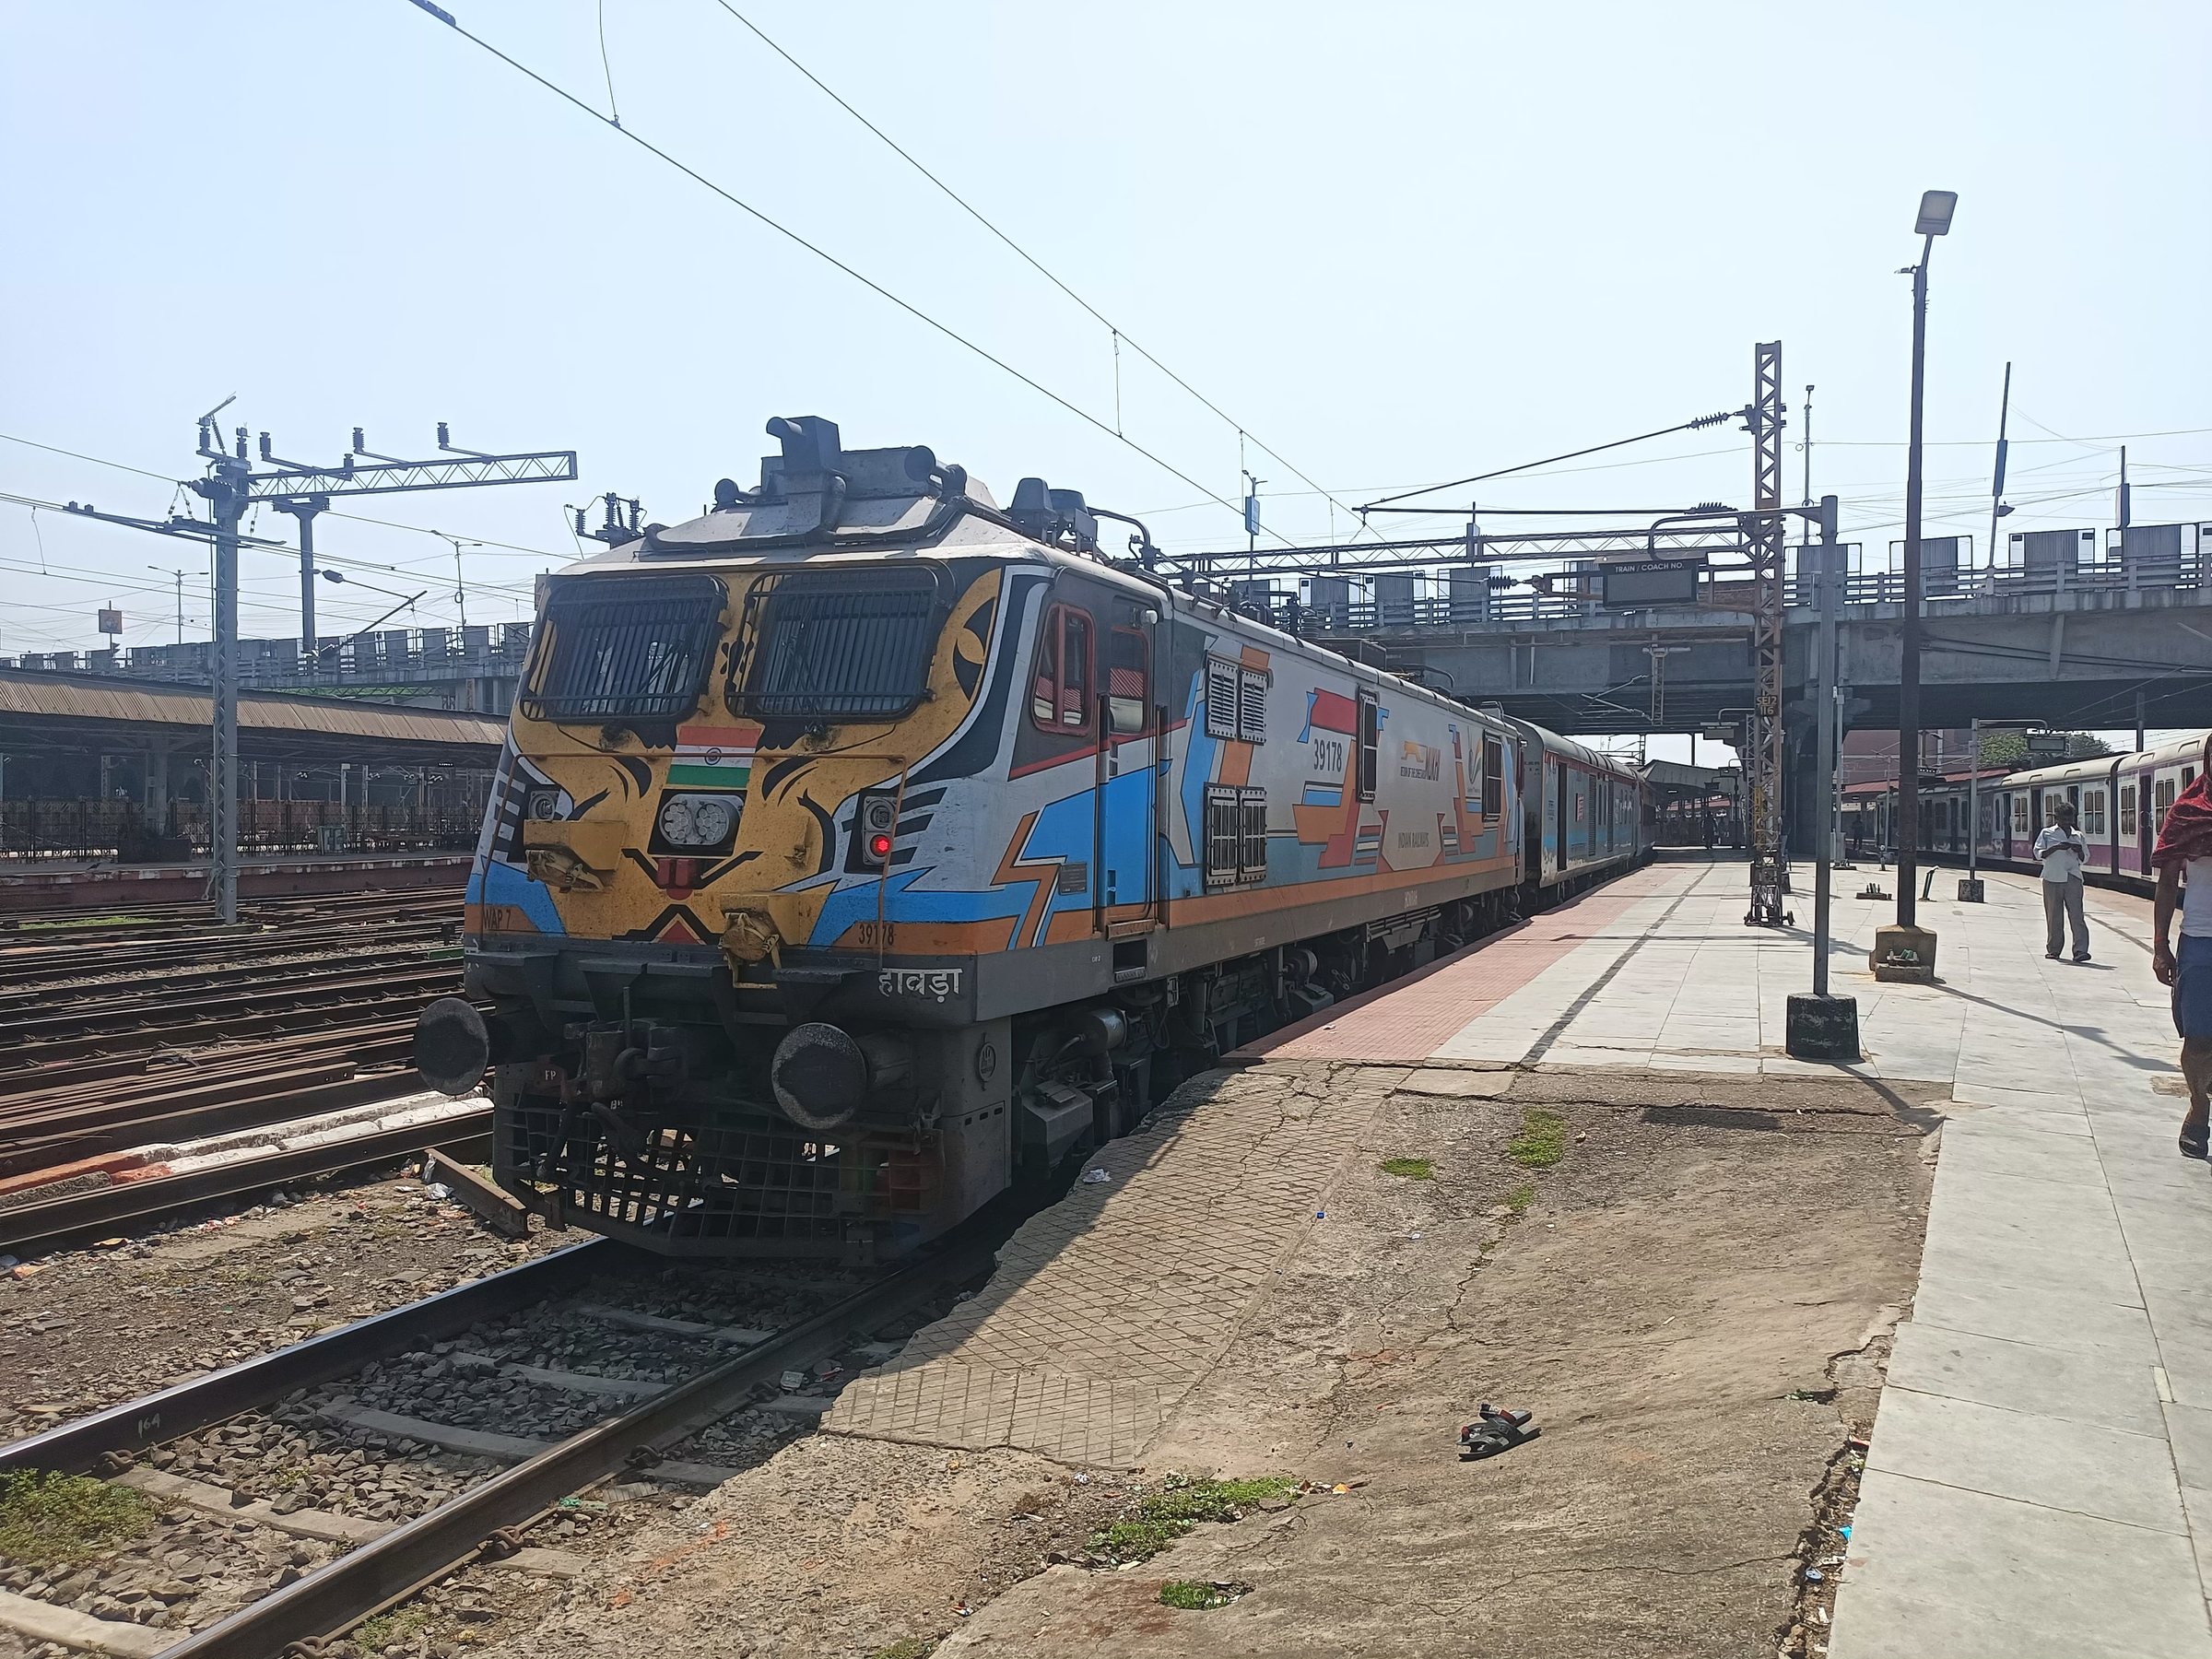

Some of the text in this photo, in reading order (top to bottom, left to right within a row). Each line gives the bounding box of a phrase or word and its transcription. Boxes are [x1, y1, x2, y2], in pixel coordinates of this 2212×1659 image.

[1641, 562, 1669, 571] COACH
[1759, 706, 1774, 715] 116
[1313, 738, 1343, 772] 39178
[482, 908, 511, 929] WAP 7
[859, 924, 894, 946] 39178
[878, 968, 962, 1003] हावड़ा
